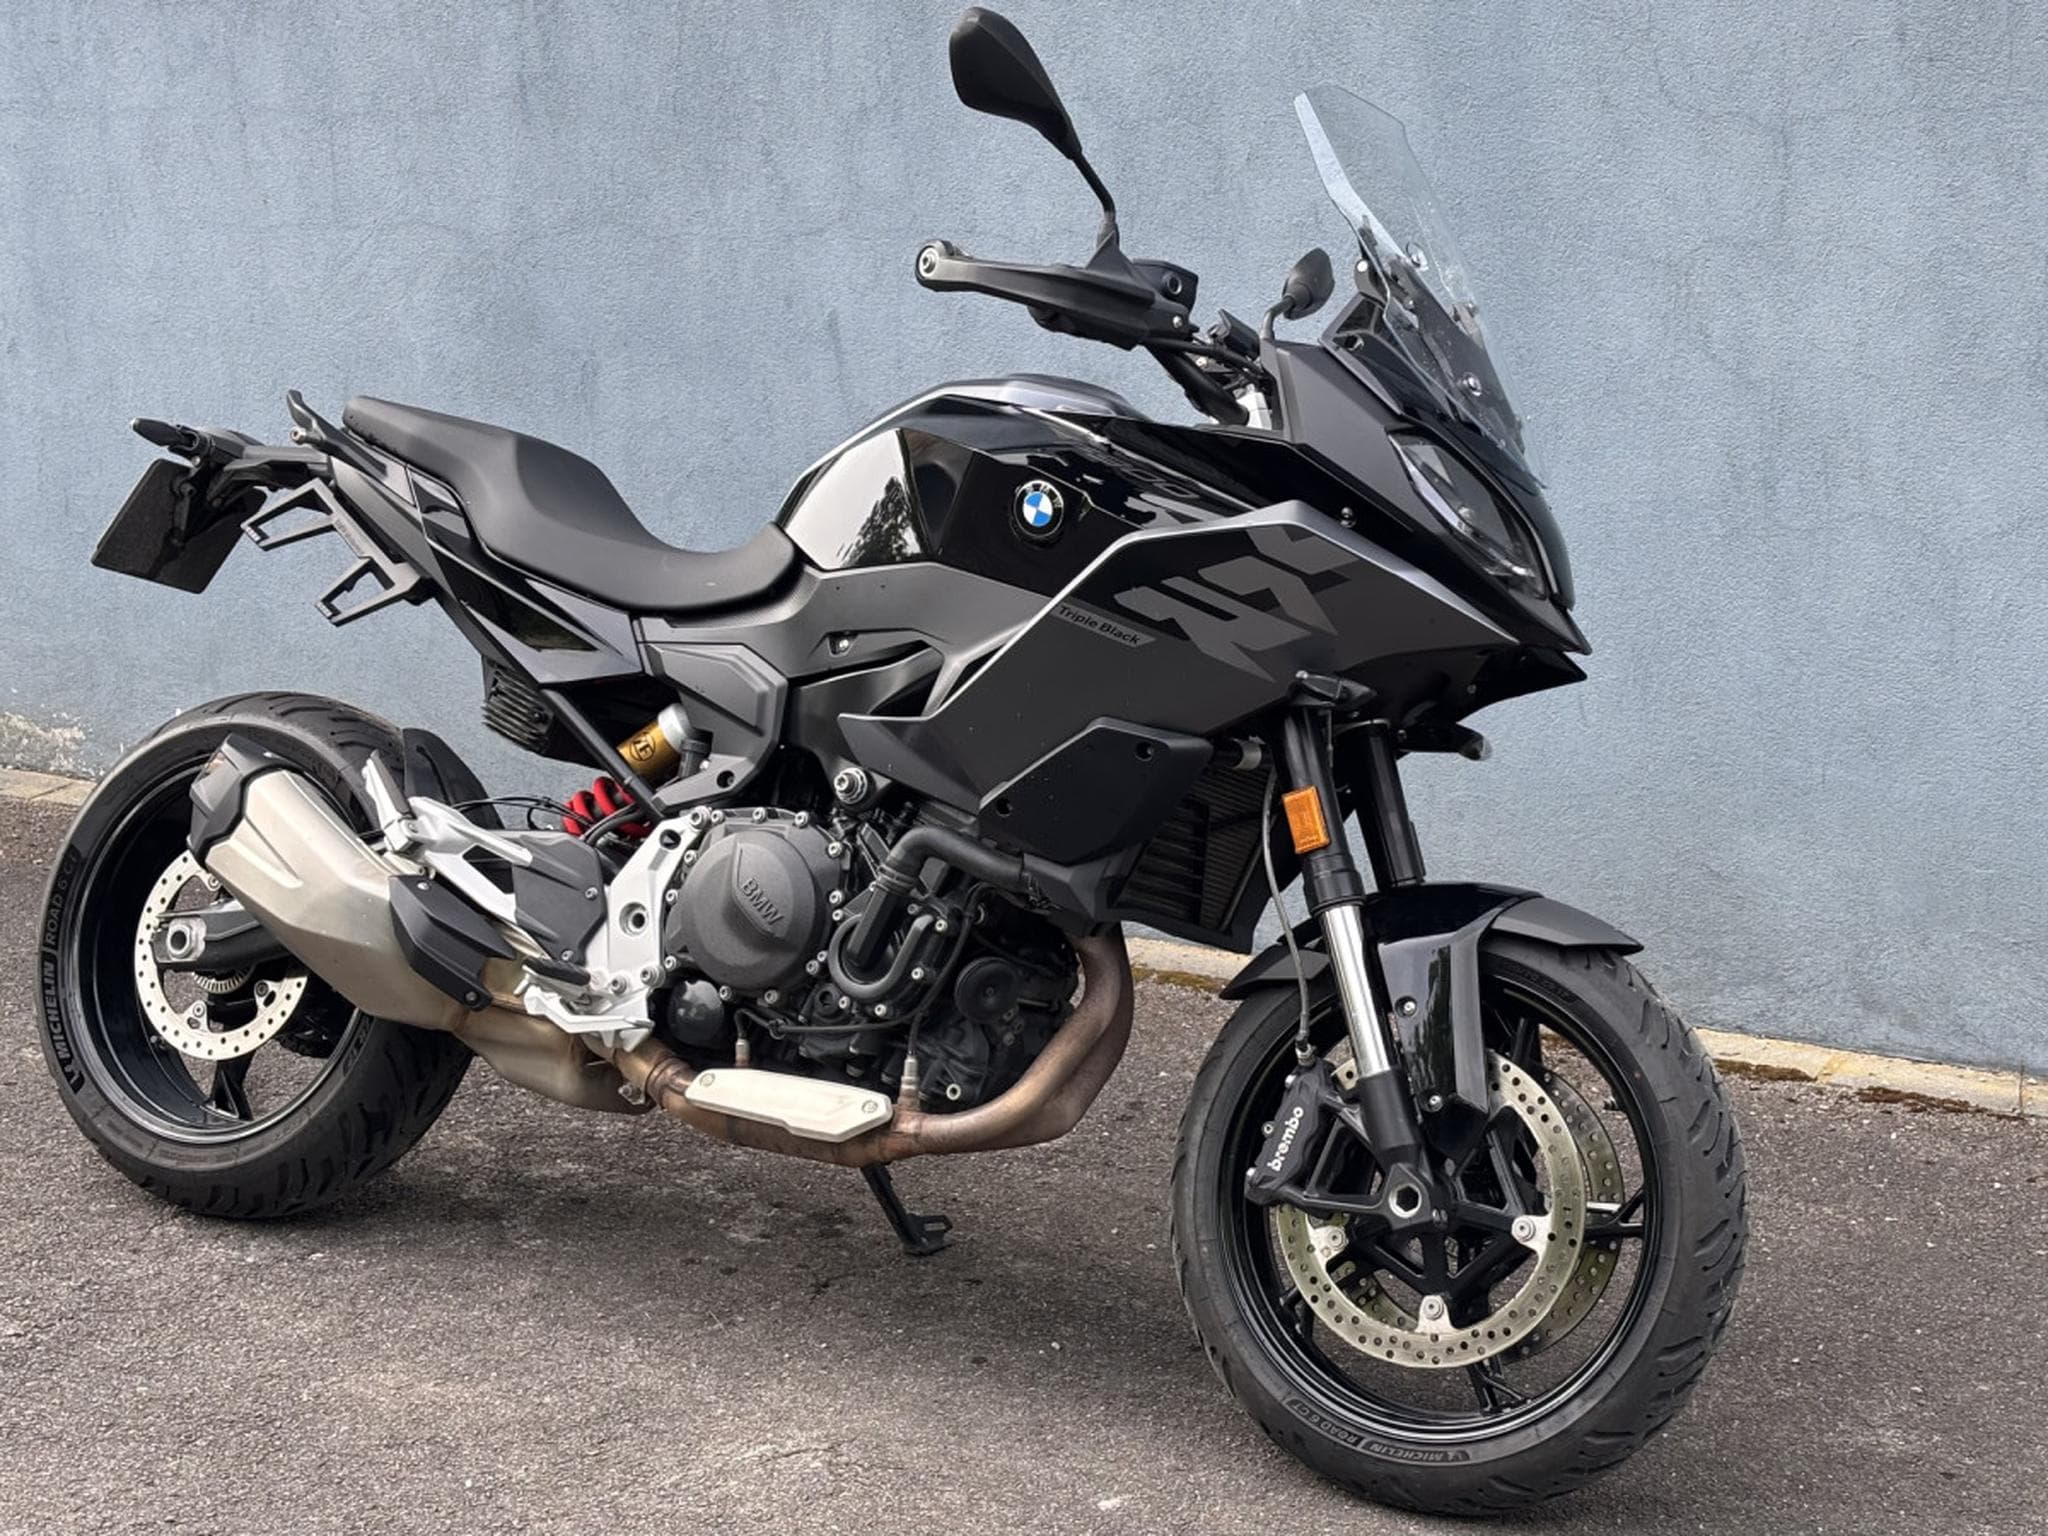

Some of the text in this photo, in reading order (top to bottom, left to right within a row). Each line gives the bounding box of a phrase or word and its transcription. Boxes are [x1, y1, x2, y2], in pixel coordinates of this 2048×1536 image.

[1059, 605, 1141, 644] Triple Black
[46, 894, 63, 946] ROAD
[743, 878, 784, 925] BMW
[43, 961, 74, 1060] MICHELIN
[1266, 1106, 1304, 1171] brembo
[1320, 1421, 1358, 1443] ROAD
[1369, 1442, 1444, 1462] MICHELIN
